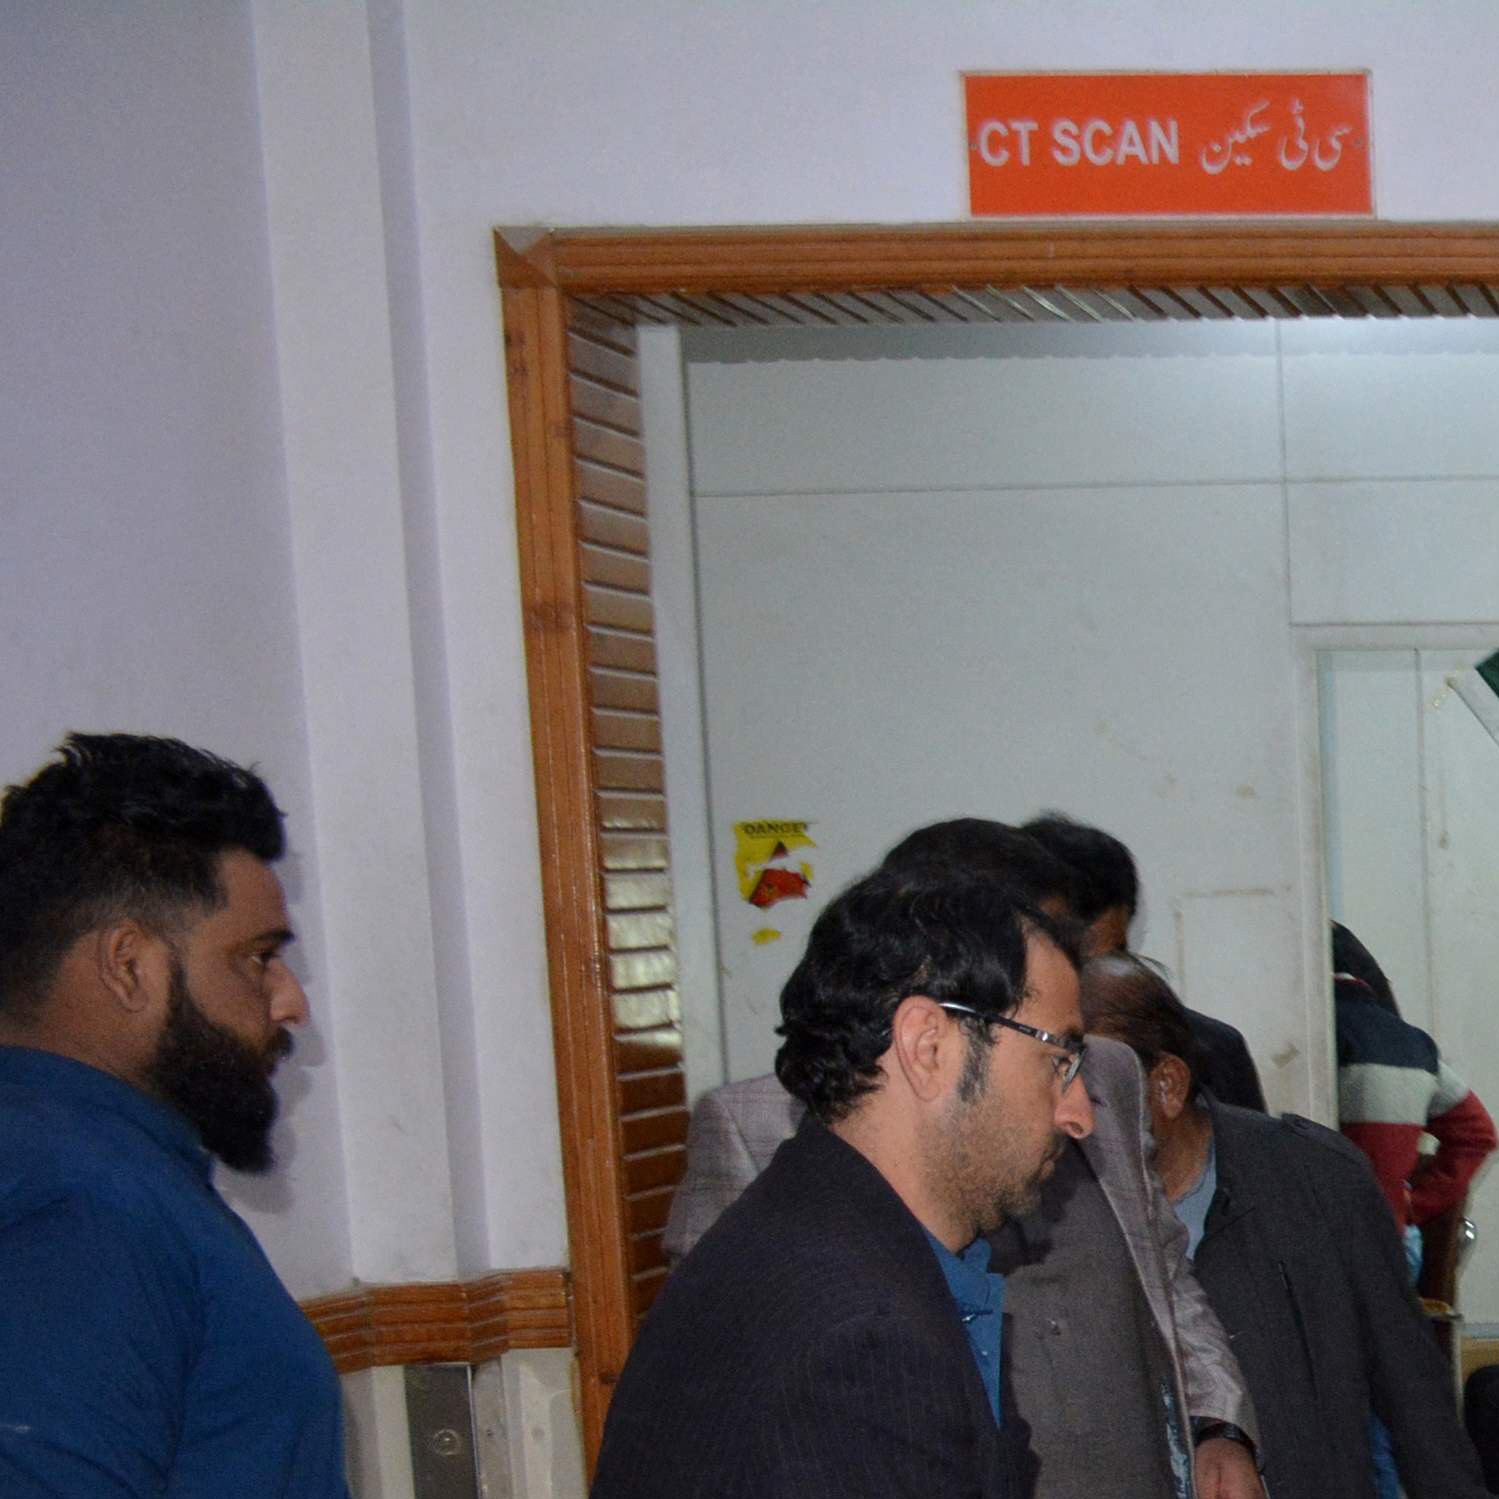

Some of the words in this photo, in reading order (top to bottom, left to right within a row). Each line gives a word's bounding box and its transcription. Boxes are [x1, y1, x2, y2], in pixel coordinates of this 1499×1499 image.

[978, 119, 1039, 166] CT
[1051, 118, 1179, 167] SCAN
[1313, 125, 1353, 171] سی
